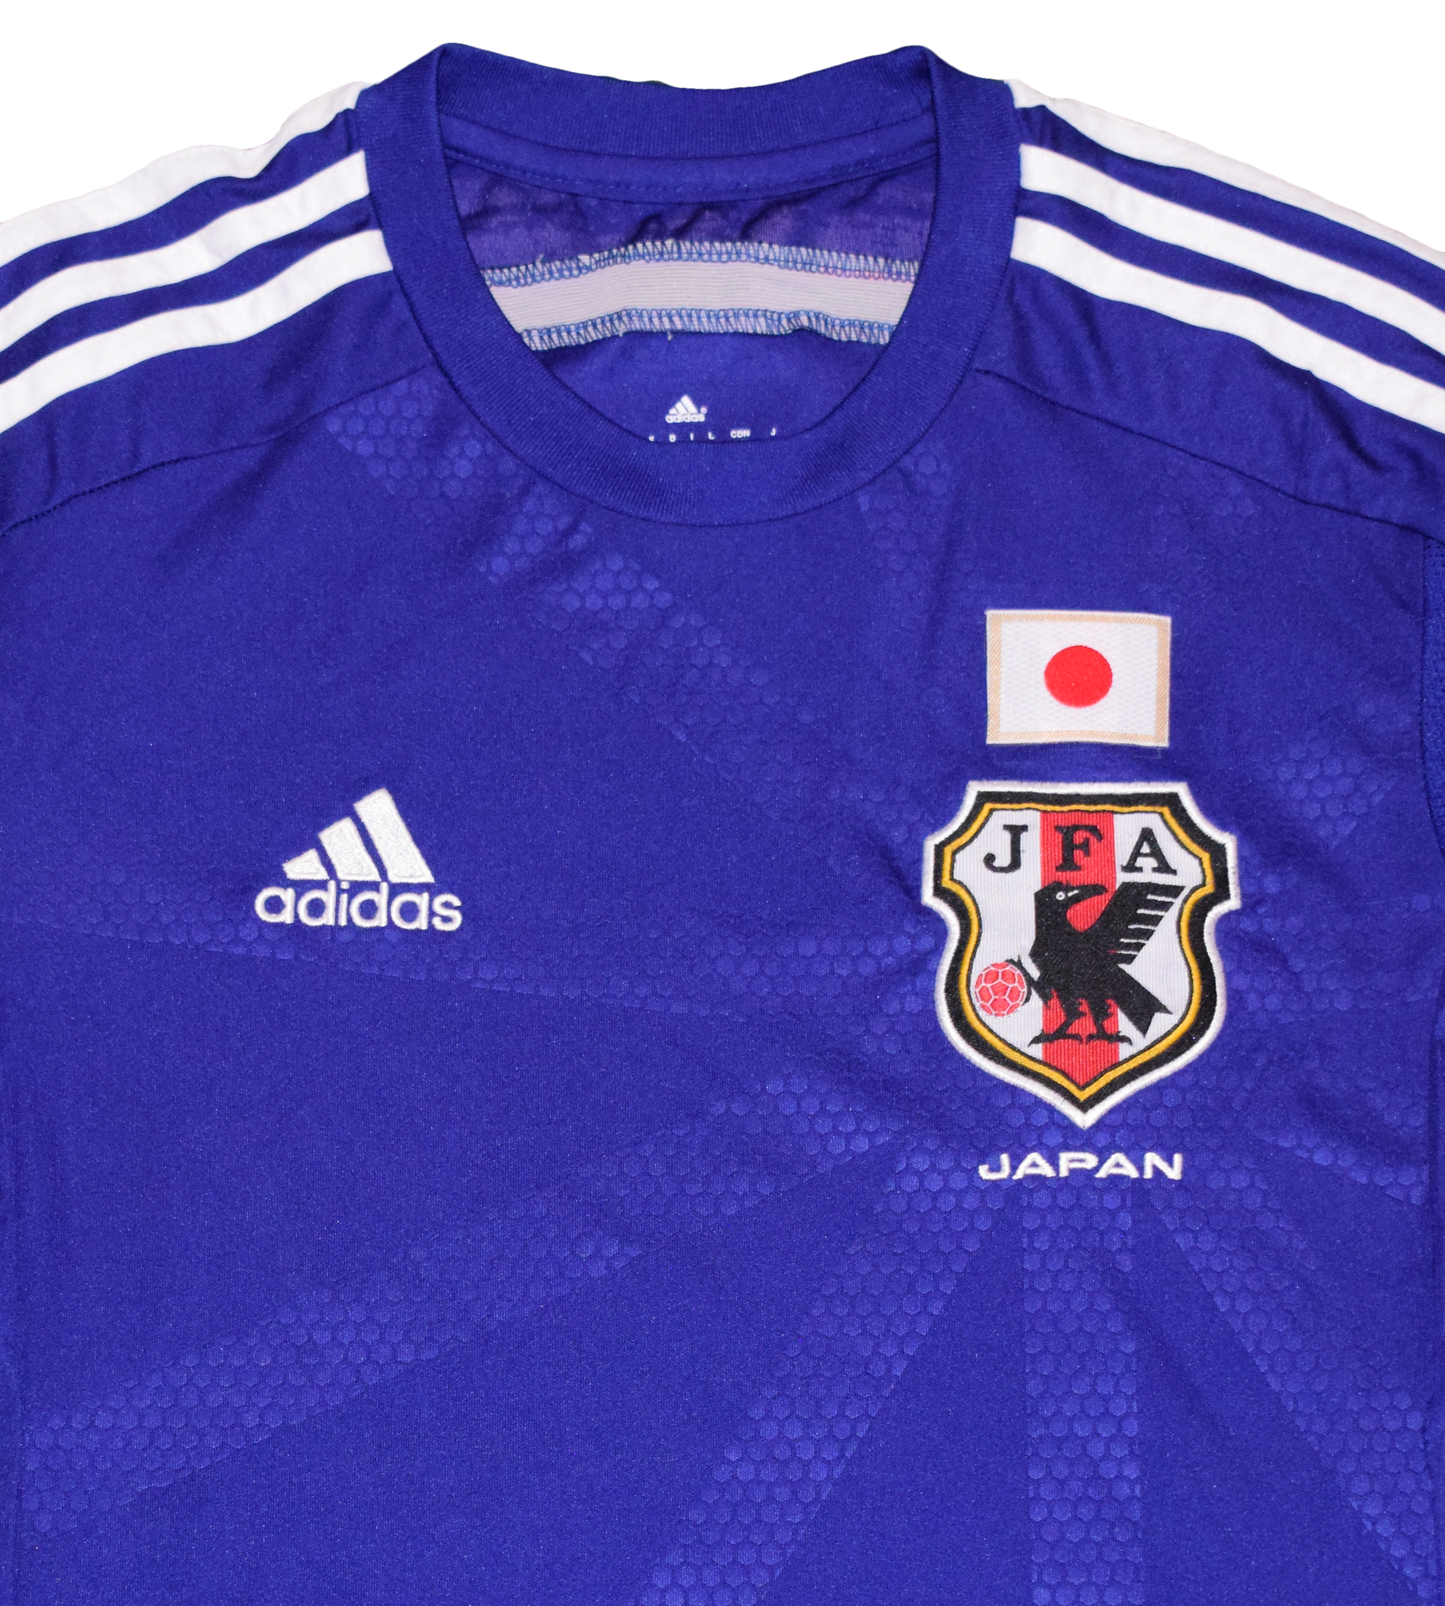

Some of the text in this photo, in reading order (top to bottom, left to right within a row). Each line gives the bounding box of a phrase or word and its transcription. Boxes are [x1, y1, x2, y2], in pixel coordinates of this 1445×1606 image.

[729, 428, 752, 439] CDN
[254, 879, 463, 932] adidas
[978, 1151, 1183, 1181] JAPAN
